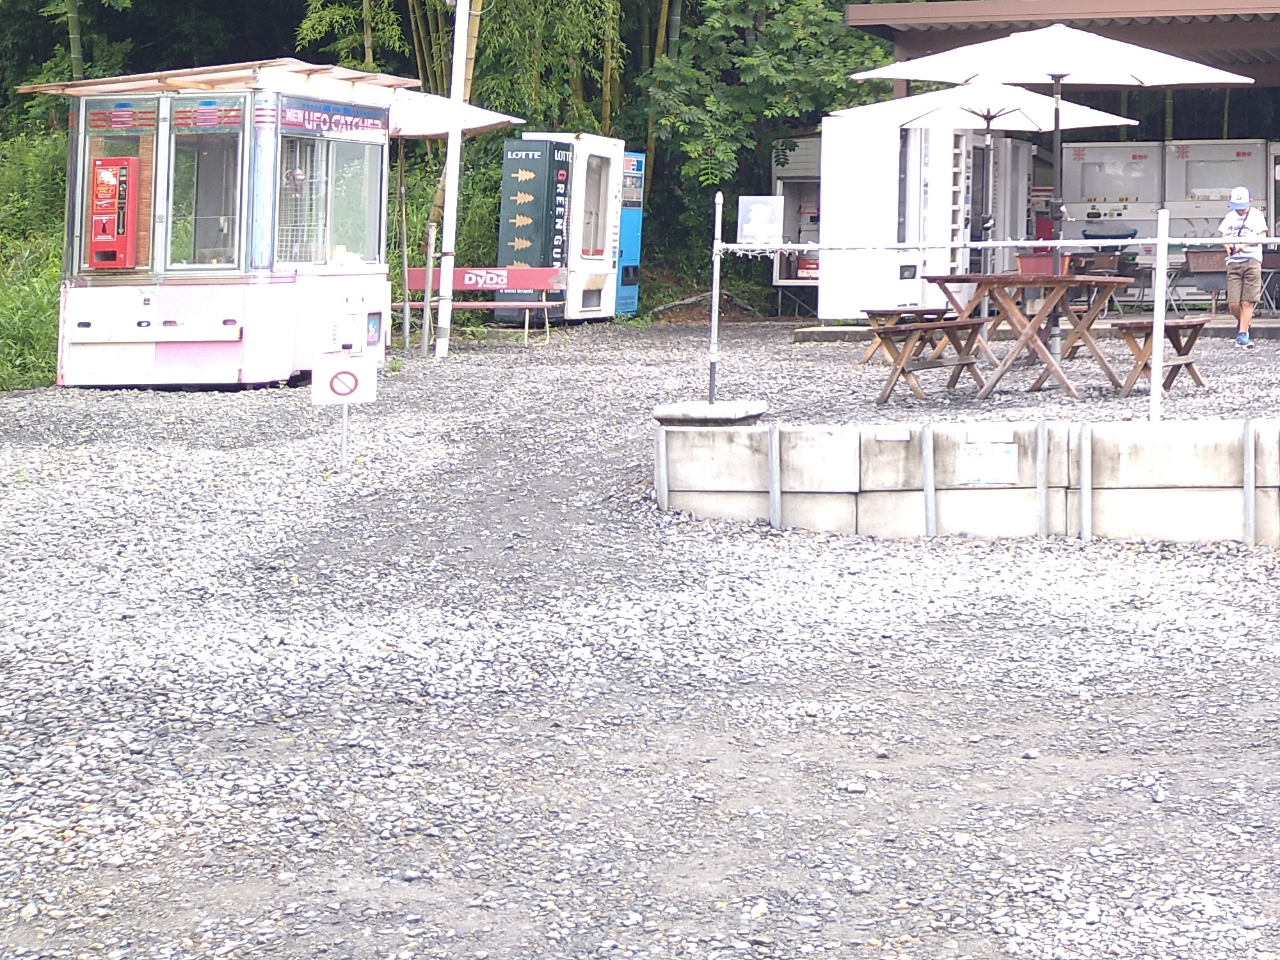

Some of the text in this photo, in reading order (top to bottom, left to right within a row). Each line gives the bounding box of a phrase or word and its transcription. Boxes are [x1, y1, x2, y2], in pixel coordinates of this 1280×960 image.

[286, 108, 304, 123] NEW
[304, 110, 330, 131] UFO
[507, 151, 542, 159] LOTTE
[554, 149, 573, 163] LOTTE
[555, 169, 567, 230] GREEN
[464, 272, 508, 288] DyDo
